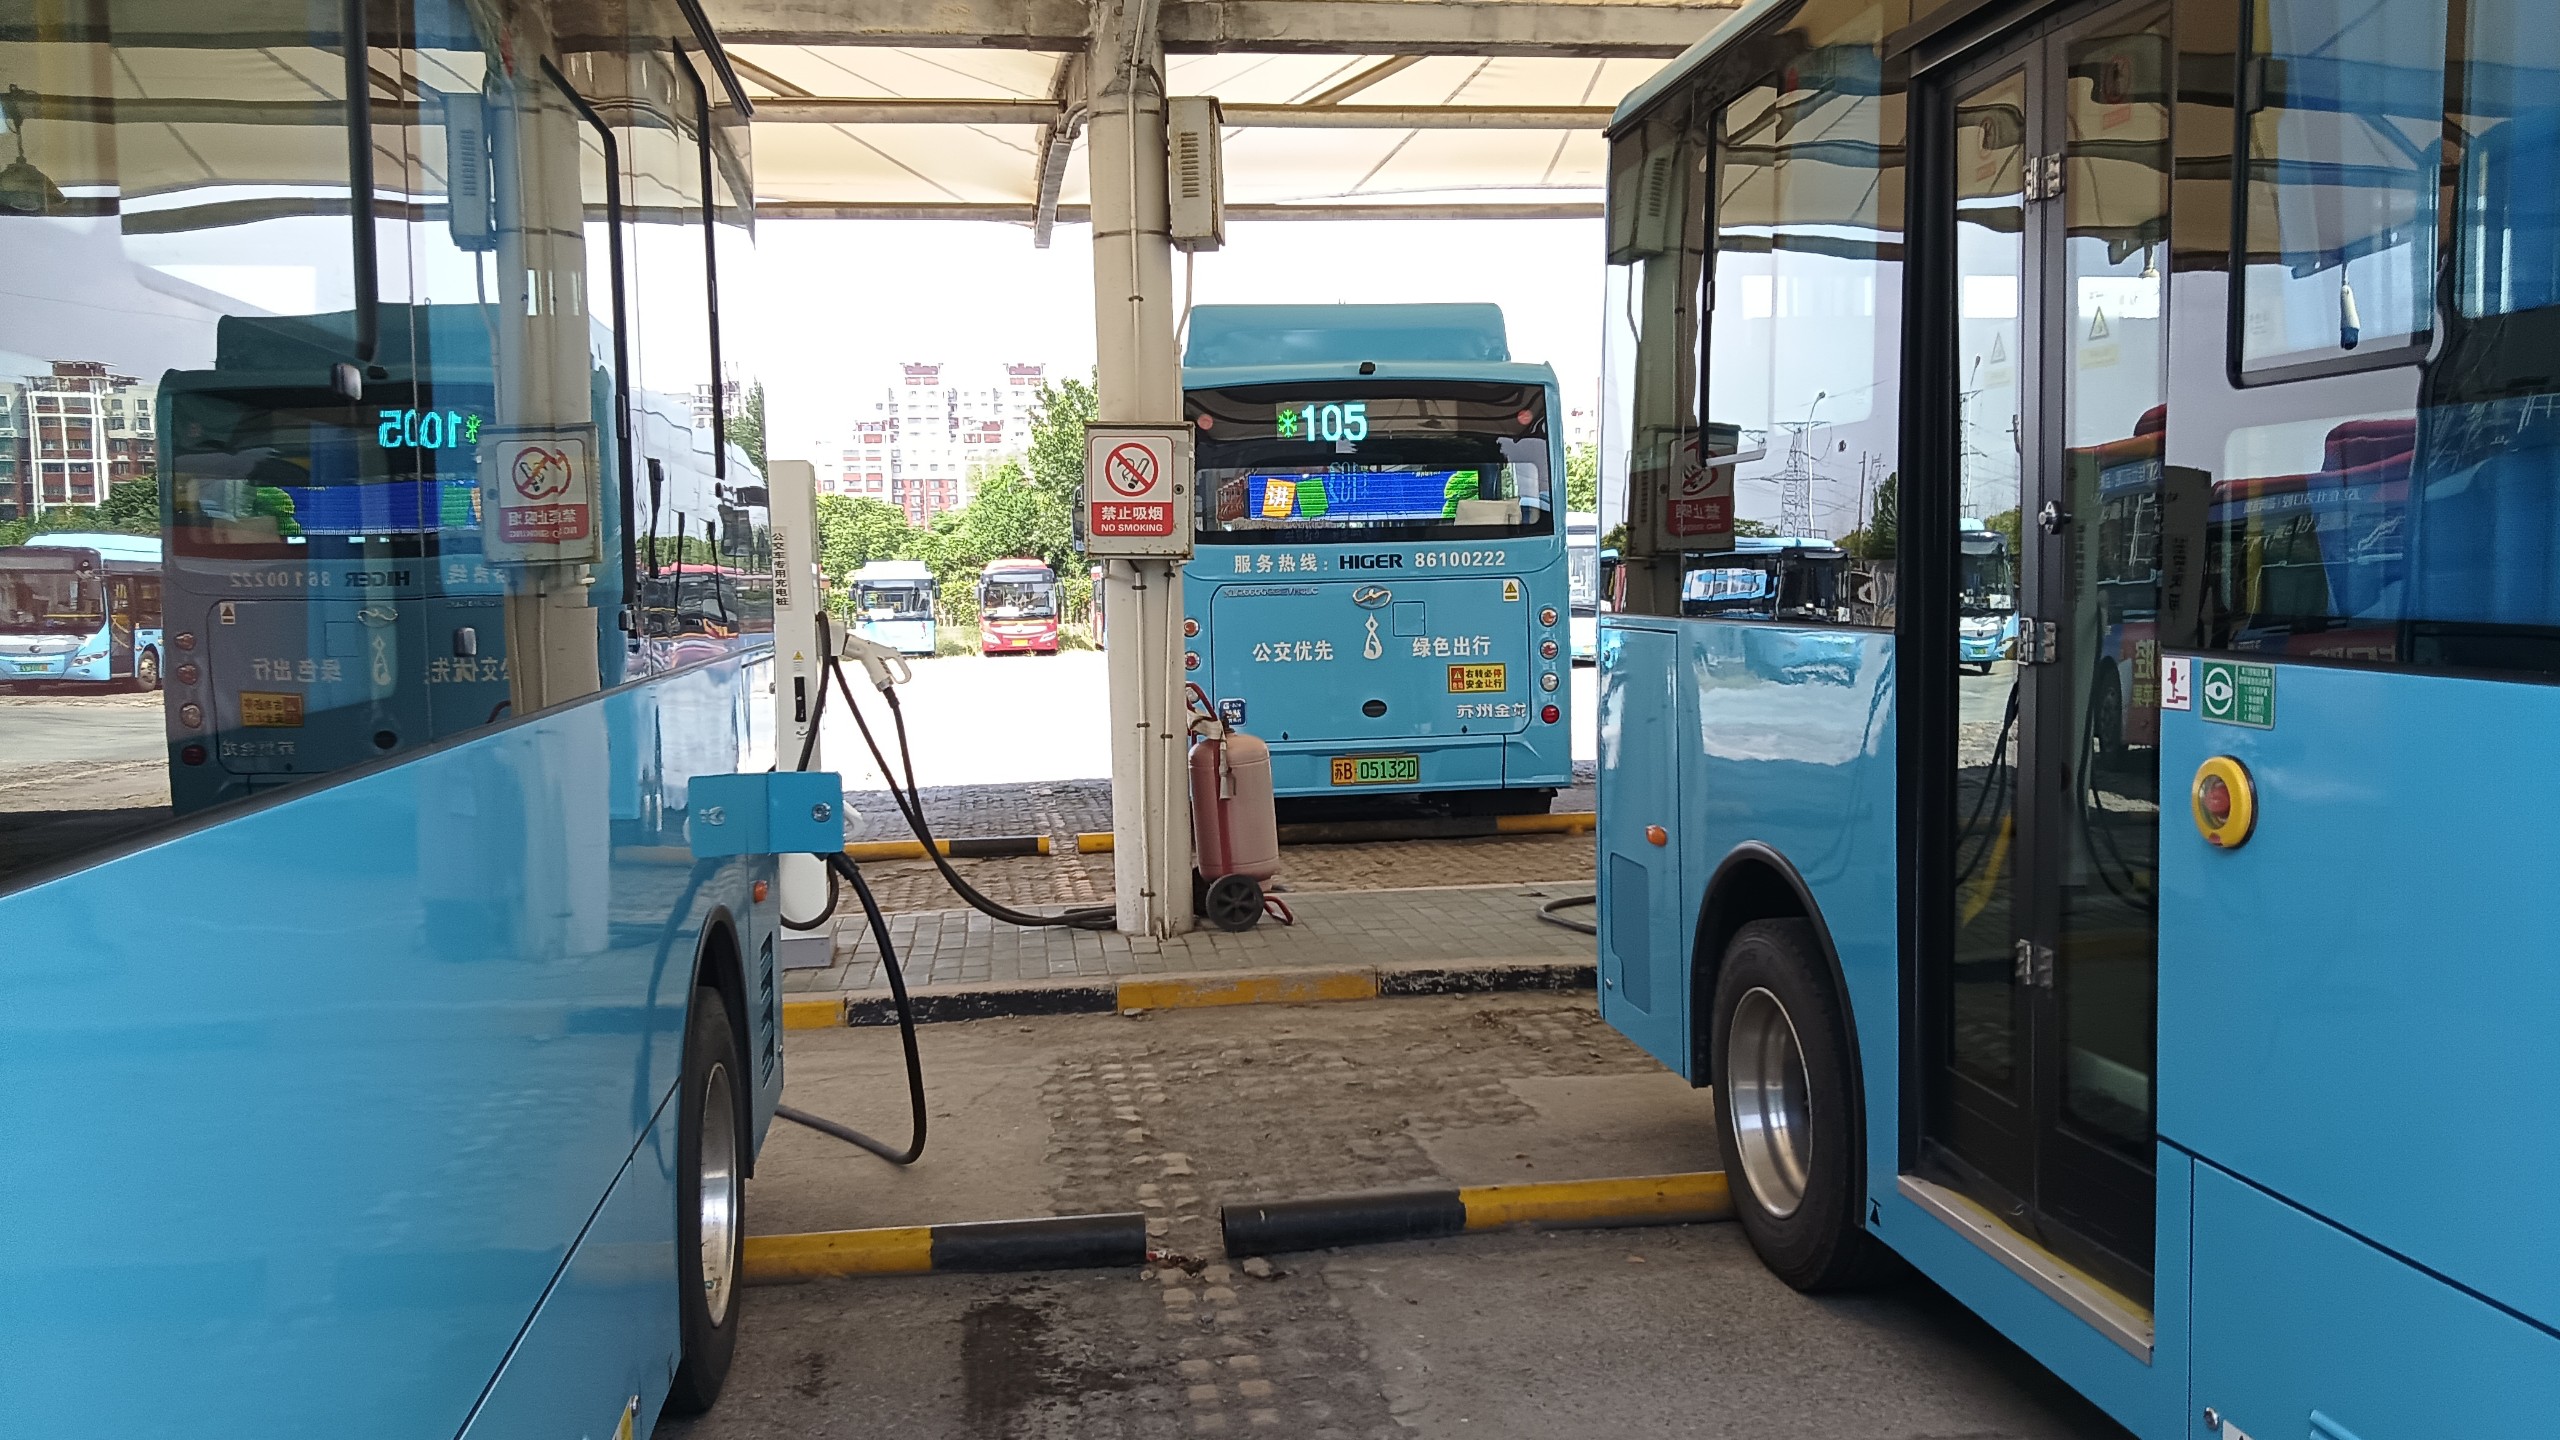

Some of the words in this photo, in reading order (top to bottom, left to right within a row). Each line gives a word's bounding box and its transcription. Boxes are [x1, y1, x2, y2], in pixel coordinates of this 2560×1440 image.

[1301, 403, 1368, 443] 105
[1267, 485, 1289, 509] 讲
[1101, 506, 1163, 521] 禁止吸烟
[1101, 523, 1116, 532] NO
[1118, 523, 1163, 532] SMOKING
[772, 532, 789, 606] 公交车专用充电桩
[1338, 552, 1404, 570] HIGER
[1414, 551, 1506, 569] 86100222
[1252, 639, 1334, 664] 公交优先
[1412, 635, 1491, 658] 绿色出行
[1465, 668, 1503, 679] 右转必停
[1465, 679, 1503, 690] 安全让行
